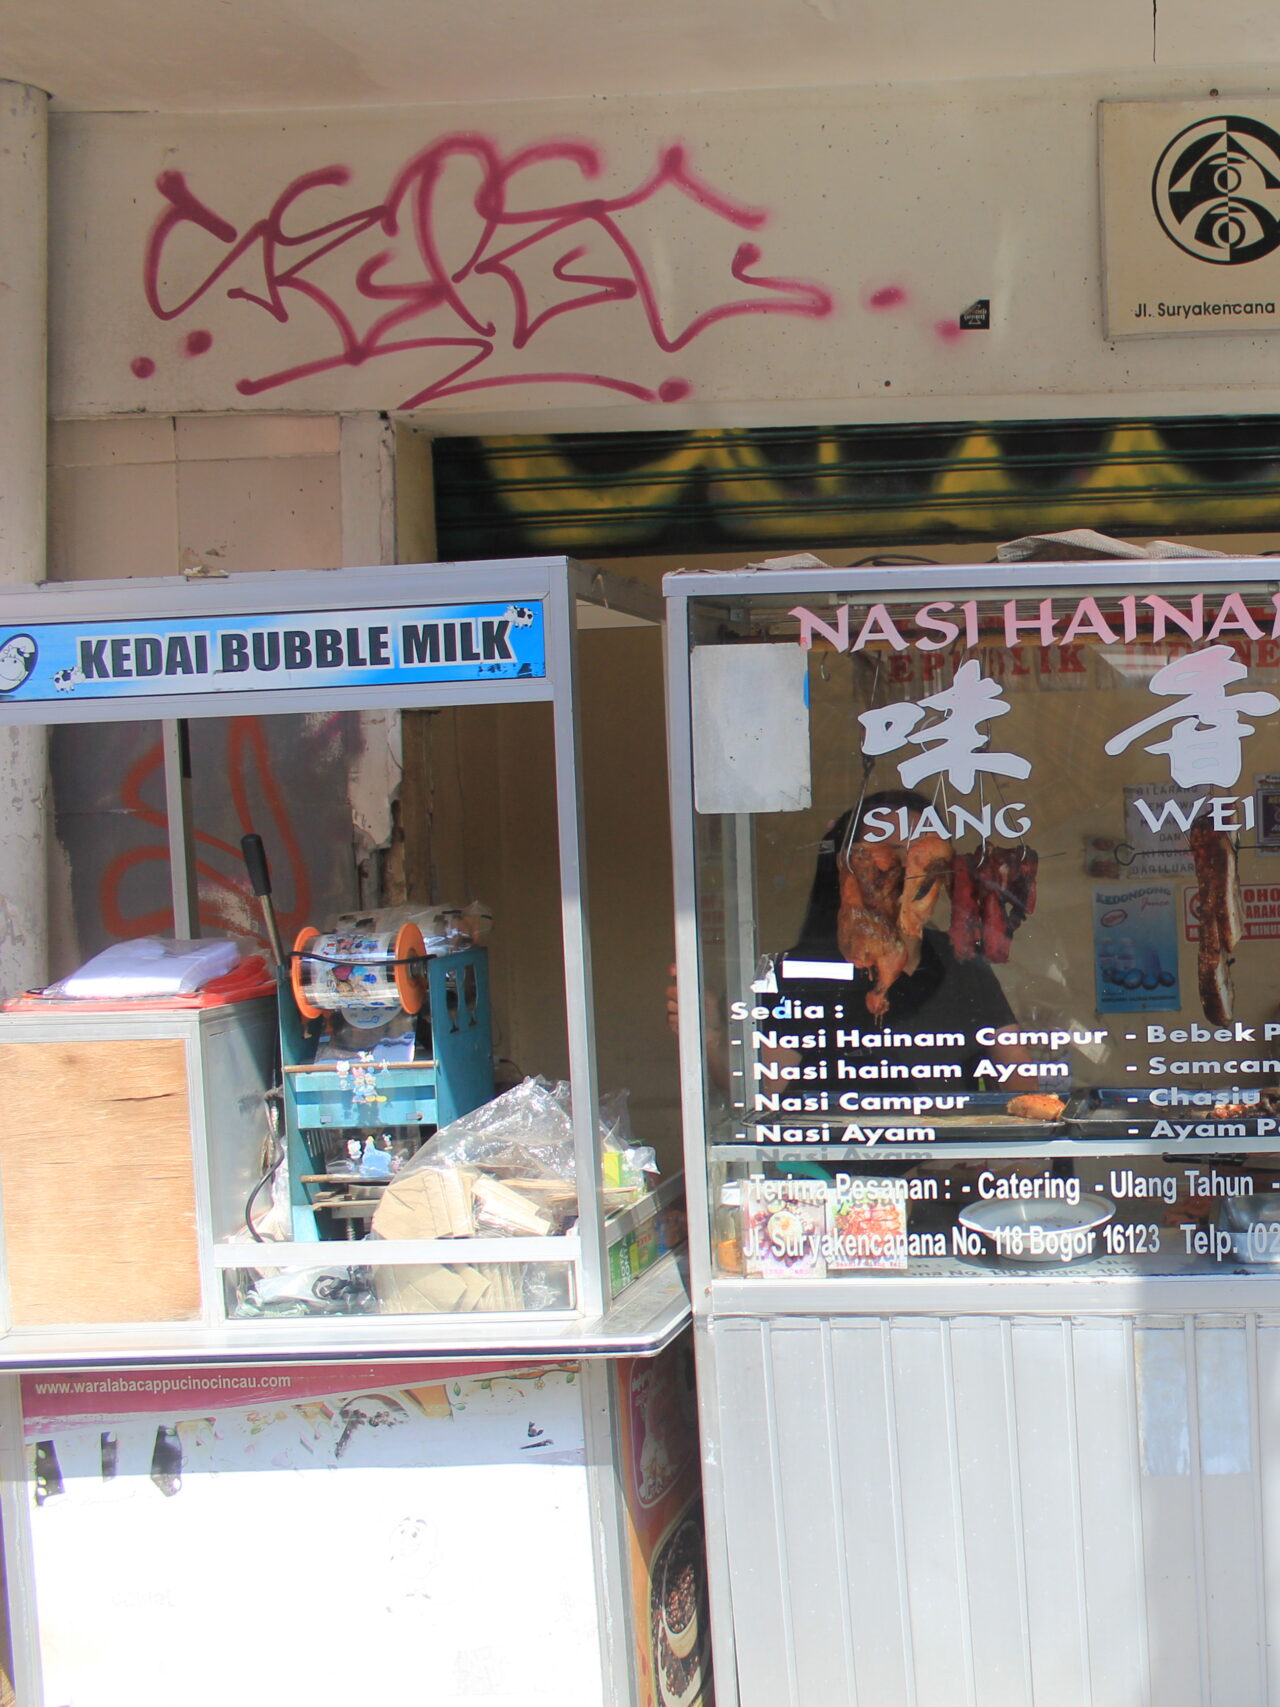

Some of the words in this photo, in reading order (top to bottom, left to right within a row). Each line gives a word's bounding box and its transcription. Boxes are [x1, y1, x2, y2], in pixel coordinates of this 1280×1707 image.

[1134, 303, 1153, 318] Jl.
[1157, 301, 1276, 320] Suryakencana
[788, 599, 979, 656] NASI
[79, 634, 210, 680] KEDAI
[220, 625, 391, 673] BUBBLE
[401, 620, 513, 665] MILK
[857, 658, 1032, 795] 味
[863, 801, 1032, 844] SIANG
[1133, 795, 1256, 835] WEI
[730, 1000, 825, 1021] Sedia
[752, 1029, 827, 1050] Nasi
[836, 1028, 966, 1049] Hainam
[975, 1027, 1108, 1051] Campur
[1147, 1022, 1256, 1044] Bebek
[753, 1060, 828, 1081] Nasi
[837, 1059, 963, 1080] hainam
[973, 1058, 1070, 1083] Ayam
[754, 1092, 829, 1113] Nasi
[839, 1091, 970, 1115] Campur
[1149, 1086, 1261, 1107] Chasiu
[755, 1124, 831, 1143] Nasi
[841, 1123, 937, 1147] Ayam
[1150, 1119, 1247, 1142] Ayam
[750, 1173, 829, 1201] Terima
[836, 1172, 939, 1202] Pesanan
[977, 1171, 1081, 1206] Catering
[1110, 1169, 1177, 1204] Ulang
[1184, 1170, 1254, 1197] Tahun
[952, 1226, 986, 1257] No.
[993, 1226, 1024, 1256] 118
[1029, 1224, 1096, 1262] Bogor
[1102, 1223, 1161, 1255] 16123
[1180, 1223, 1239, 1261] Telp.
[35, 1374, 292, 1395] www.waralabacappucinocincau.com
